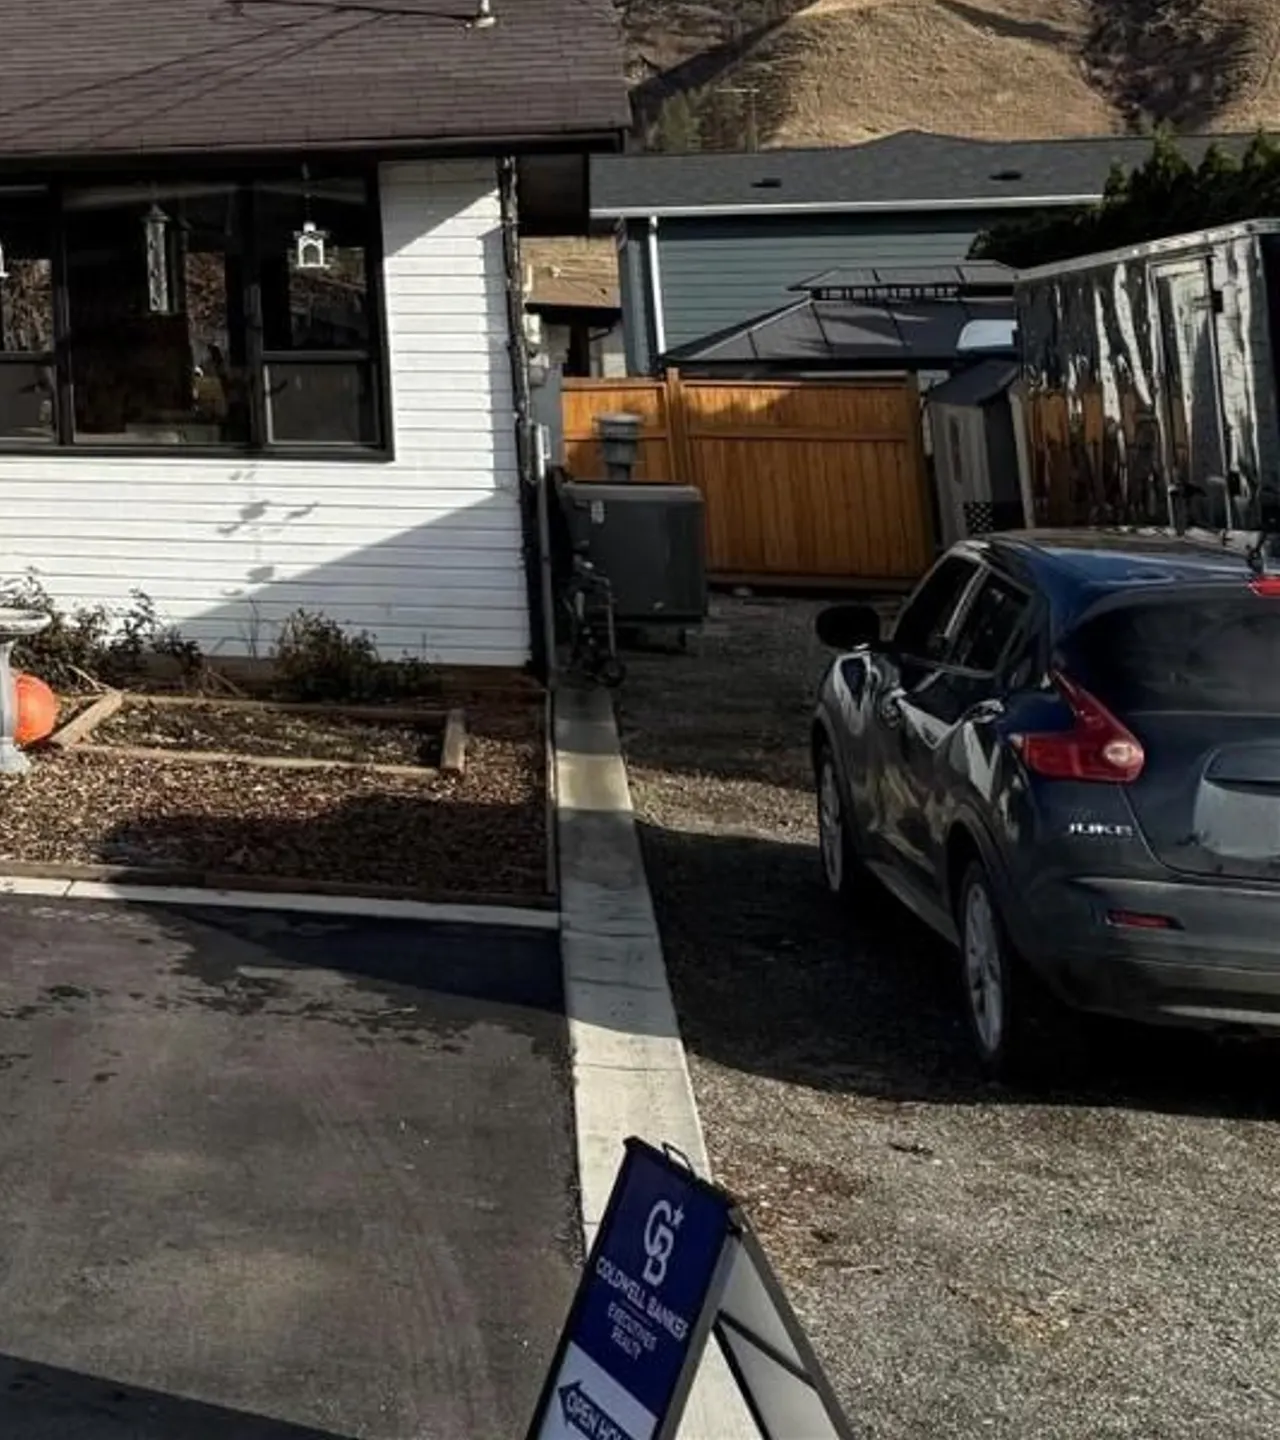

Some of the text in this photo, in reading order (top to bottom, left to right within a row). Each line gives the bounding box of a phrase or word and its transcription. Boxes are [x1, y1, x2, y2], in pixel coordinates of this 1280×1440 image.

[596, 1257, 689, 1342] COLDWELL BANKER
[567, 1390, 601, 1436] OPEN
